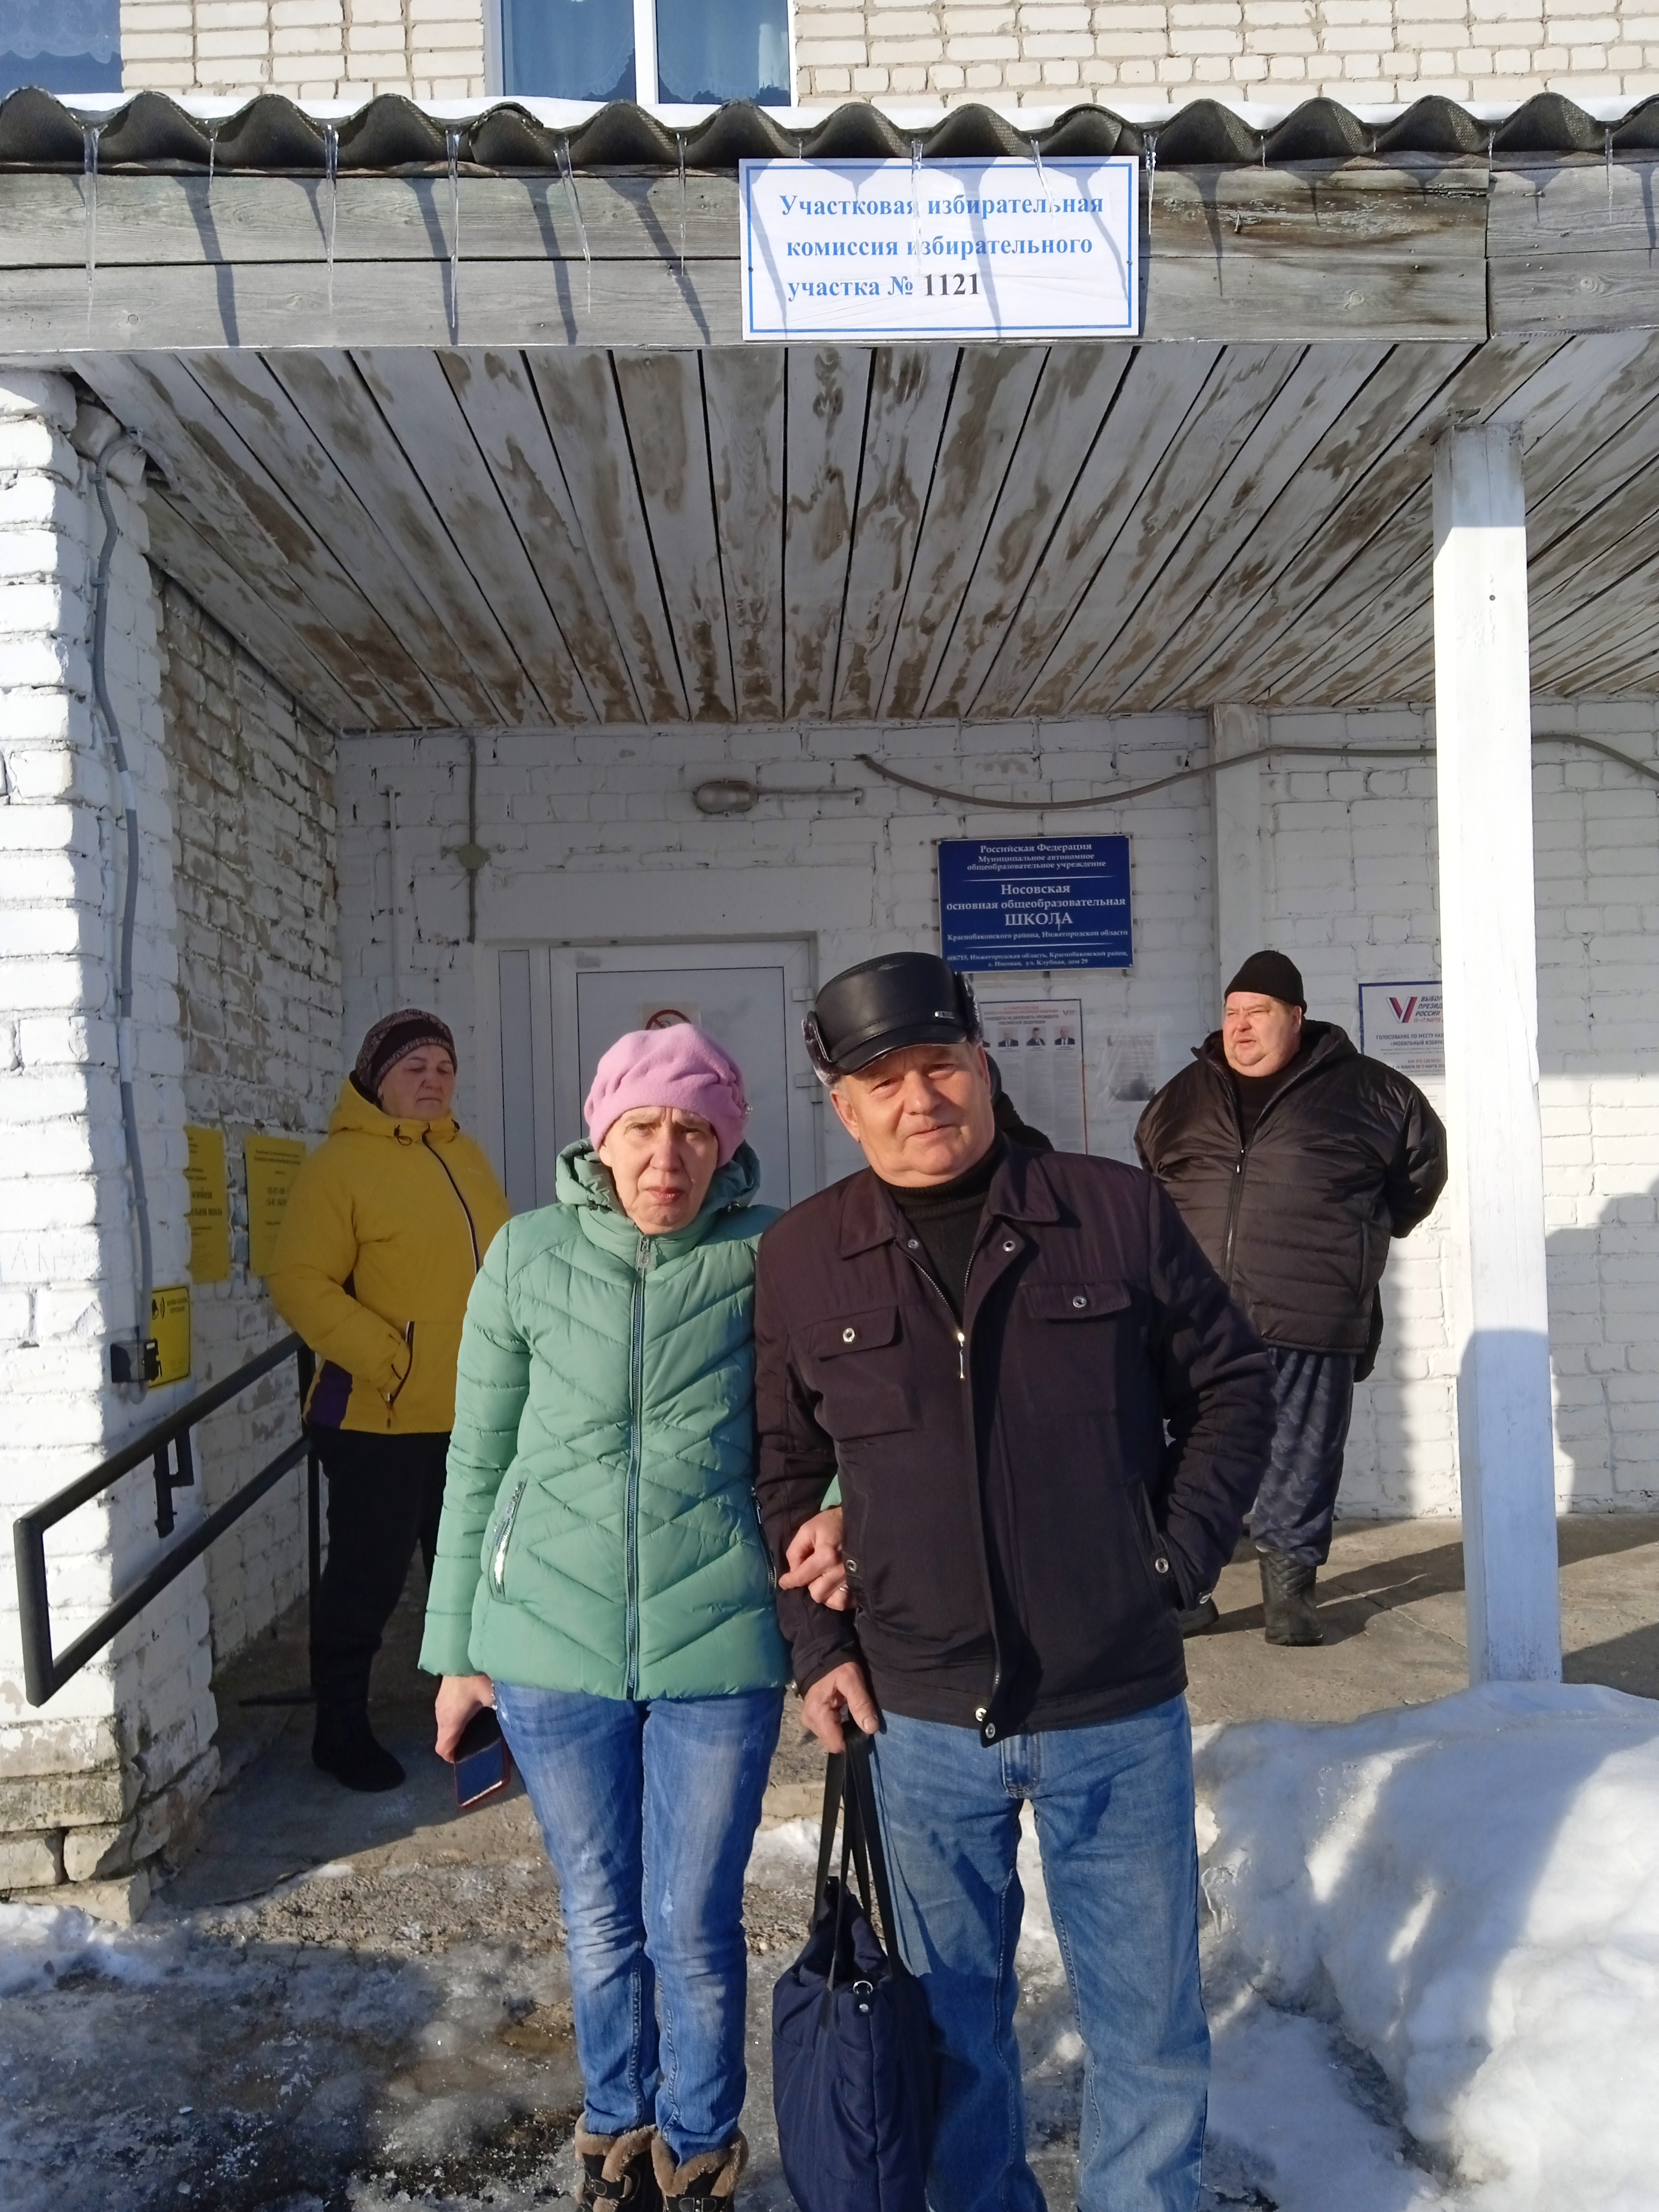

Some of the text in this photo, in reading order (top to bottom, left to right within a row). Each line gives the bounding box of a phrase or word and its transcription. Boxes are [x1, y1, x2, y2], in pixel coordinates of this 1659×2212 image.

[779, 194, 1103, 219] Участковая избирательная
[787, 236, 1093, 260] комиссия избирательного
[788, 273, 980, 302] участка № 1121
[1037, 843, 1092, 852] Федерация
[978, 856, 1046, 864] Муниципальное
[967, 861, 1107, 872] общеобразовательное учреждение
[1001, 884, 1071, 895] Носовская
[1001, 899, 1126, 910] общеобразовательная
[1004, 912, 1073, 926] ШКОЛА
[947, 933, 1012, 942] Краснобаковского
[1042, 930, 1099, 939] Нижегородской
